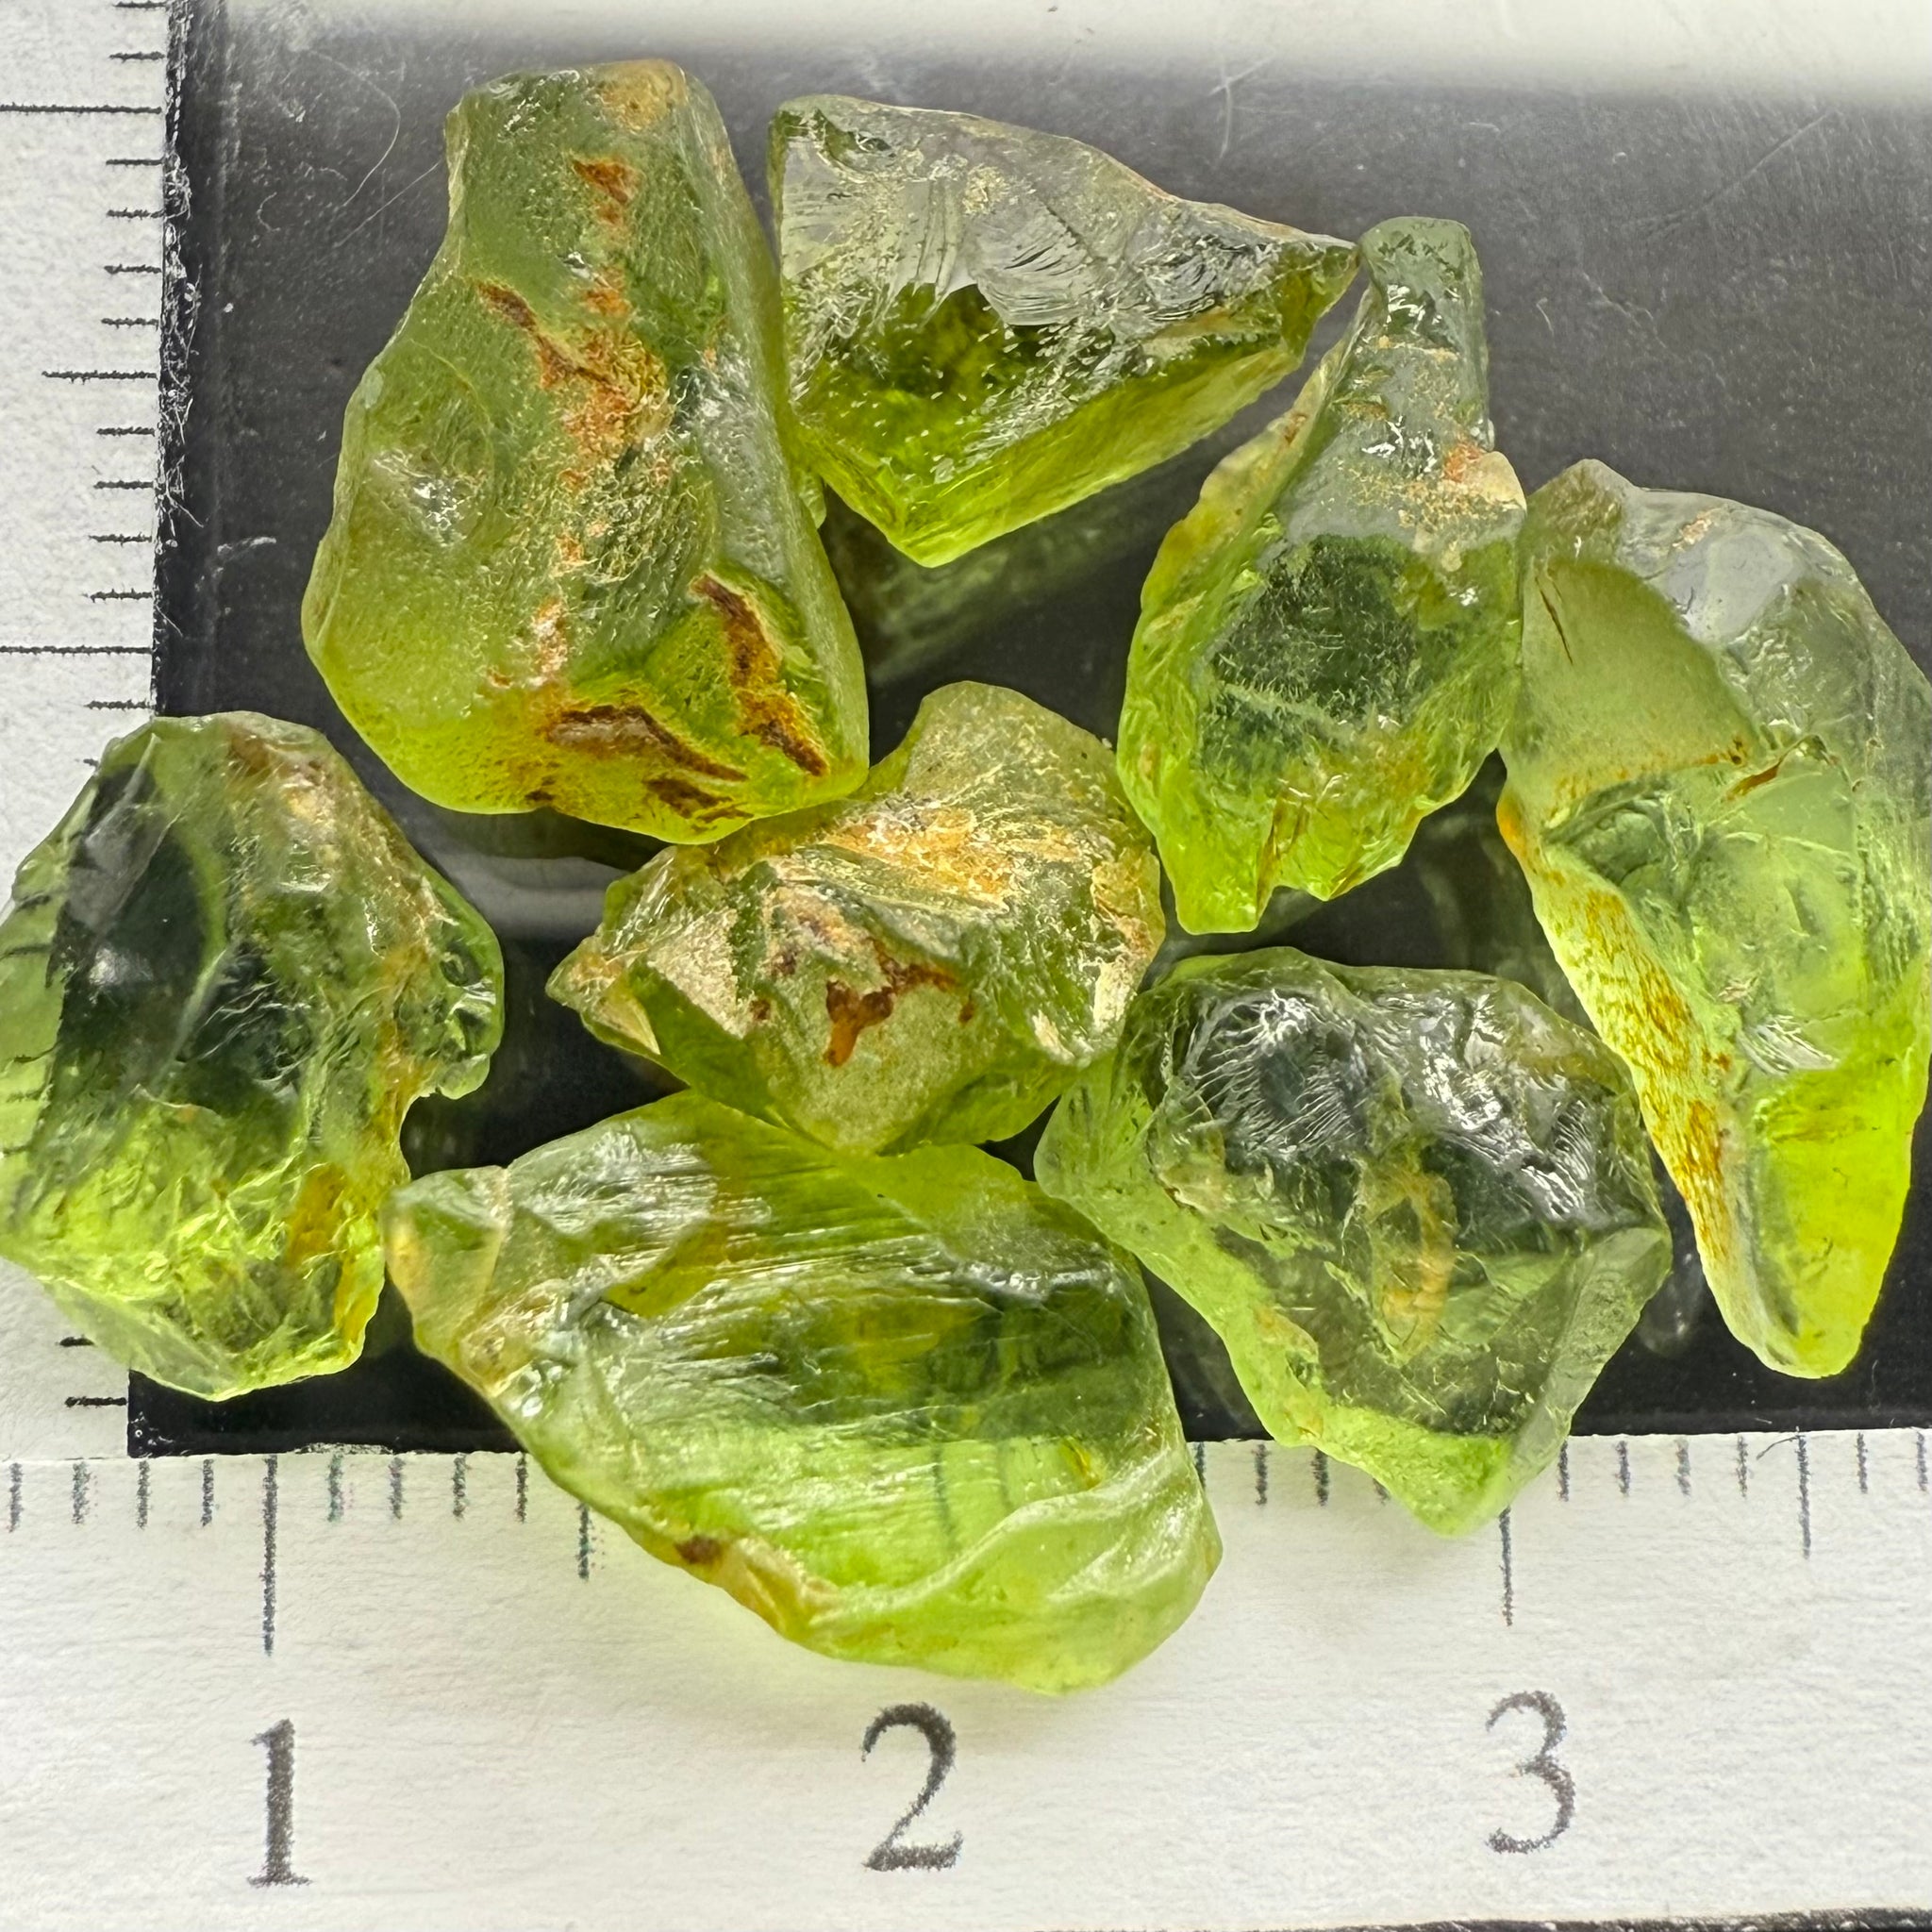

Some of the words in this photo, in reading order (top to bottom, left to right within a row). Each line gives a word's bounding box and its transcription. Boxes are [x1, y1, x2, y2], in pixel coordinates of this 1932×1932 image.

[246, 1719, 310, 1886] 1
[861, 1702, 961, 1872] 2
[1487, 1690, 1576, 1855] 3
